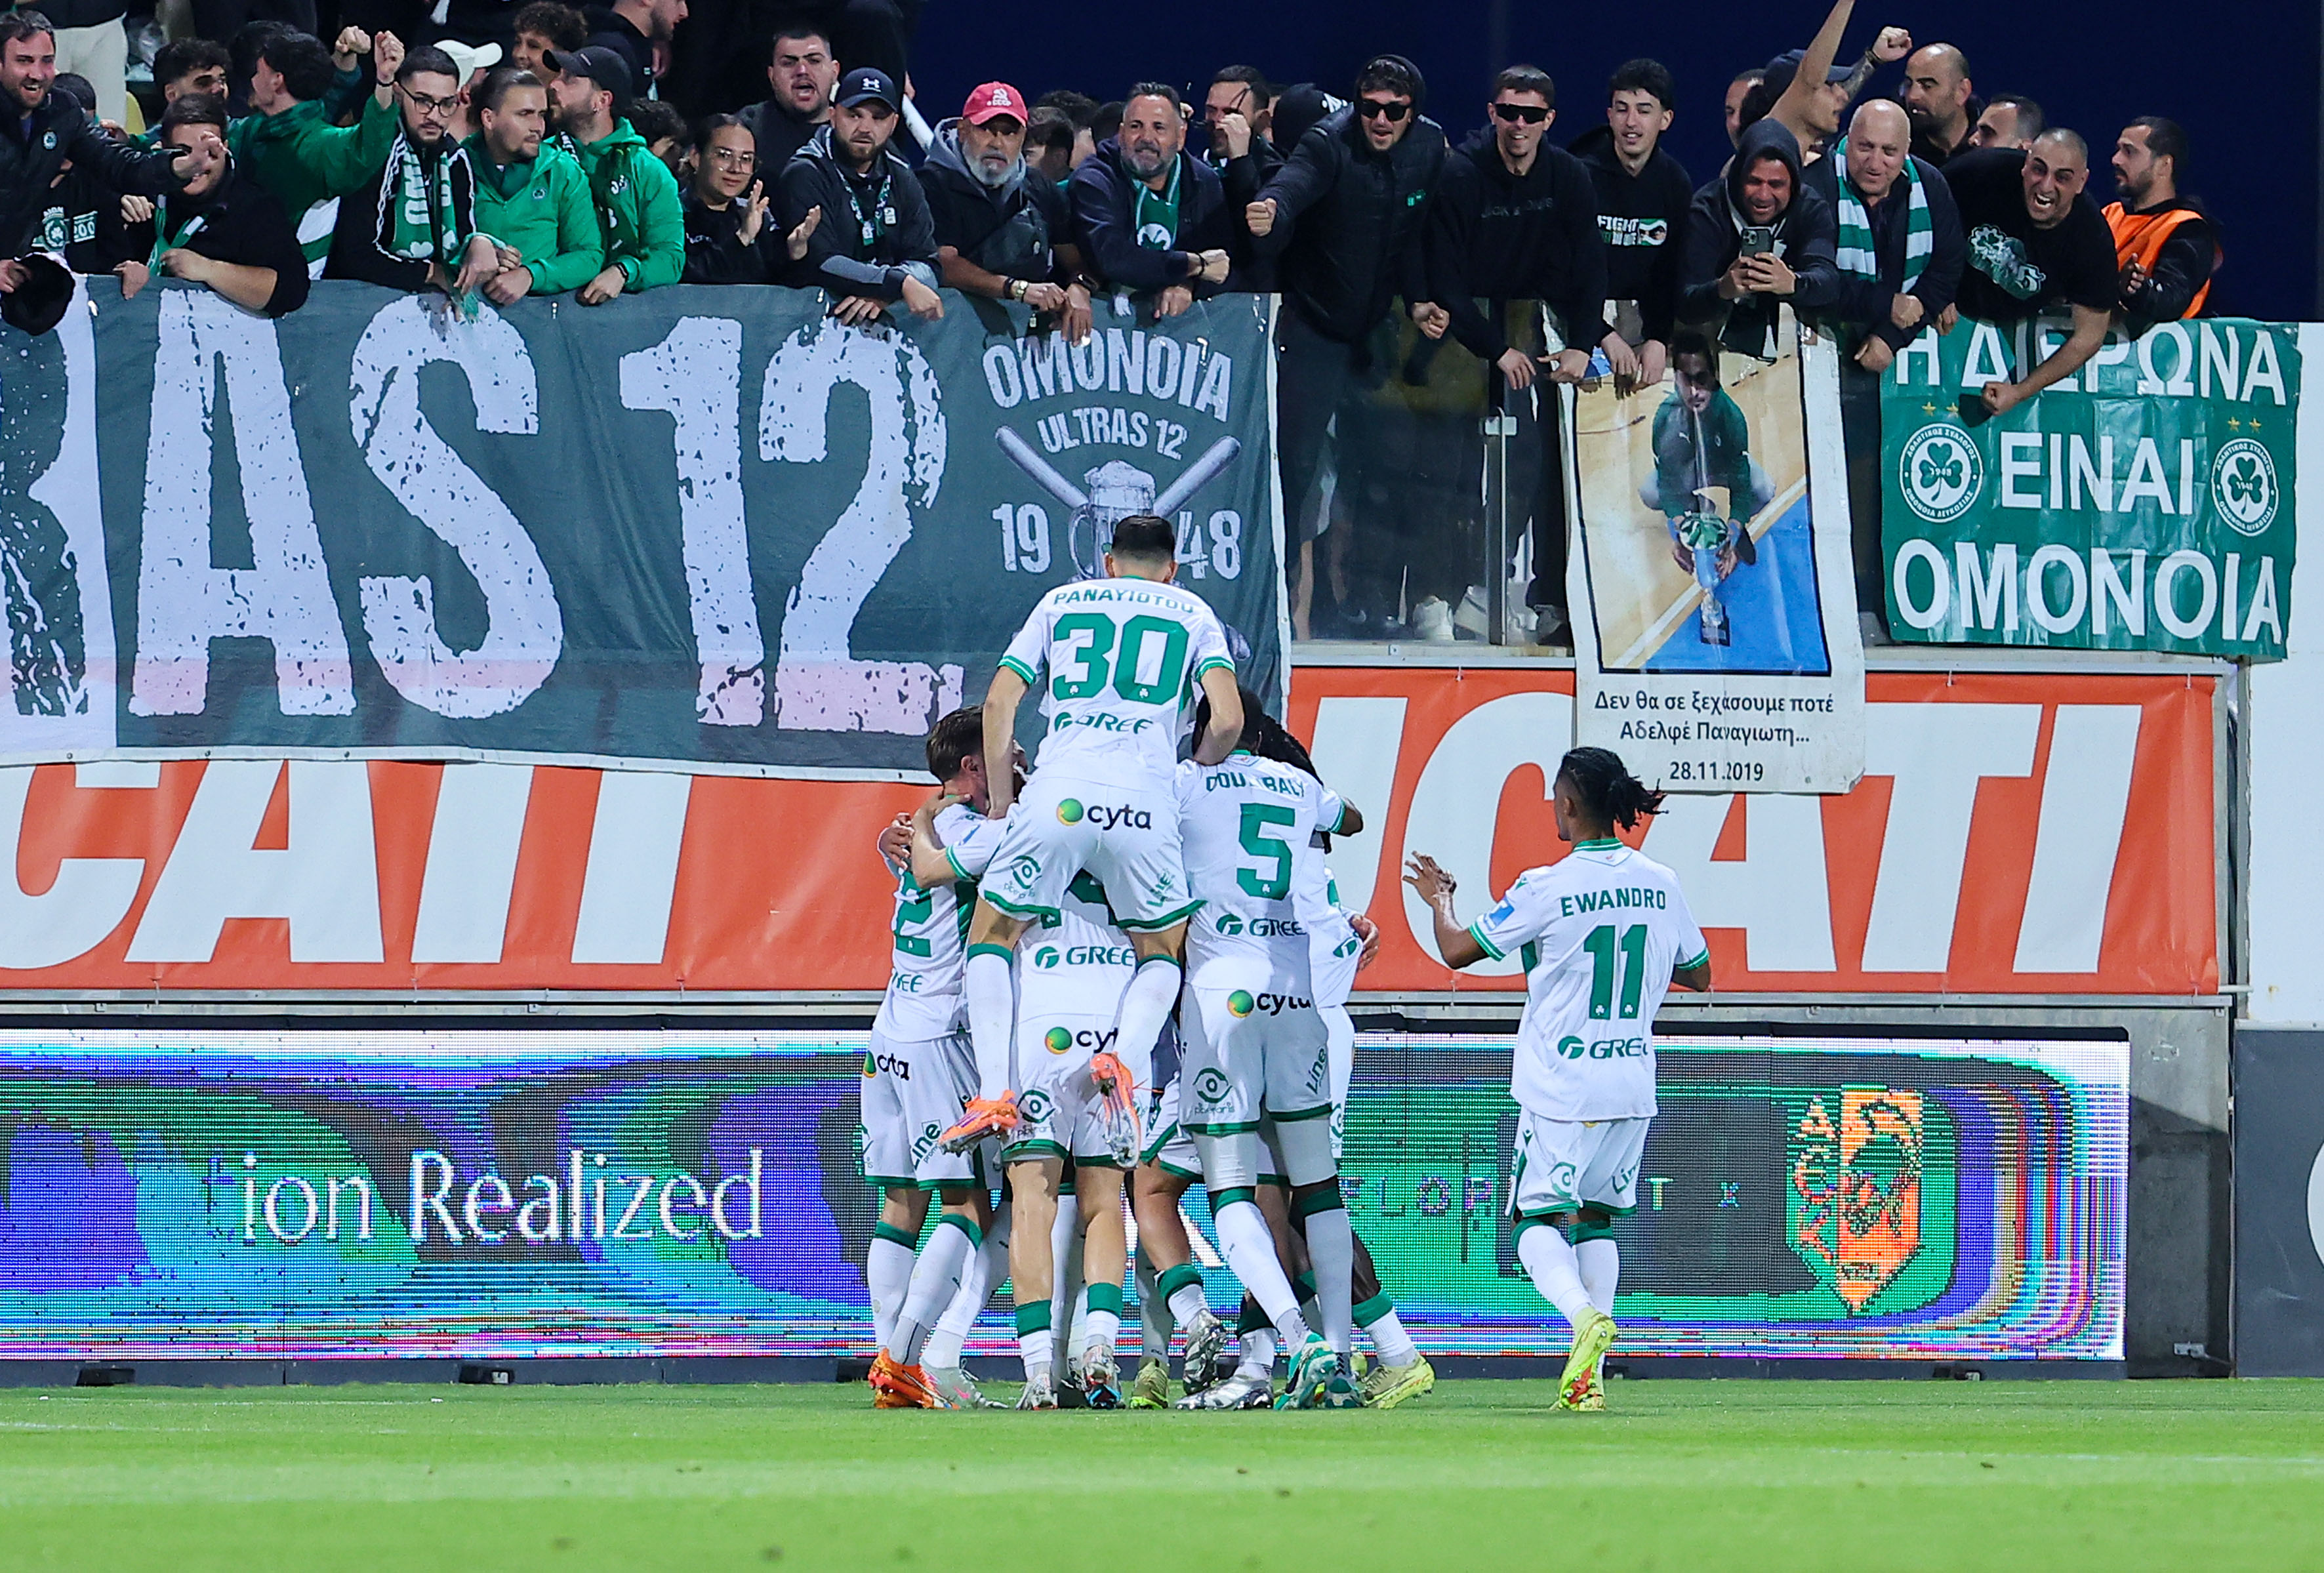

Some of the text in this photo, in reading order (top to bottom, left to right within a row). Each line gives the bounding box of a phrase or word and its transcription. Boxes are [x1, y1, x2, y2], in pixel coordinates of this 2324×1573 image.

[1597, 215, 1639, 232] FIGHT
[1037, 407, 1188, 460] ULTRAS 12
[2001, 431, 2195, 515] ΕΙΝΑΙ
[620, 316, 964, 735] 12
[992, 503, 1241, 580] 19 48
[1053, 589, 1194, 613] PANAYIOTOU
[1893, 539, 2283, 644] ΟΜΟΝΟΙΑ
[1053, 613, 1189, 705] 30
[1595, 691, 1834, 715] Δεν θα σε ξεχάσουμε ποτέ
[1620, 720, 1690, 745] Αδελφέ
[1670, 762, 1764, 781] 28.11.2019
[1088, 804, 1151, 831] cyta
[1236, 802, 1295, 901] 5
[1560, 887, 1666, 917] EWANDRO
[1250, 918, 1307, 937] GREE
[1066, 946, 1135, 967] GREE
[1583, 924, 1648, 1020] 11
[1589, 1038, 1648, 1059] GRE
[410, 1147, 762, 1244] Realized
